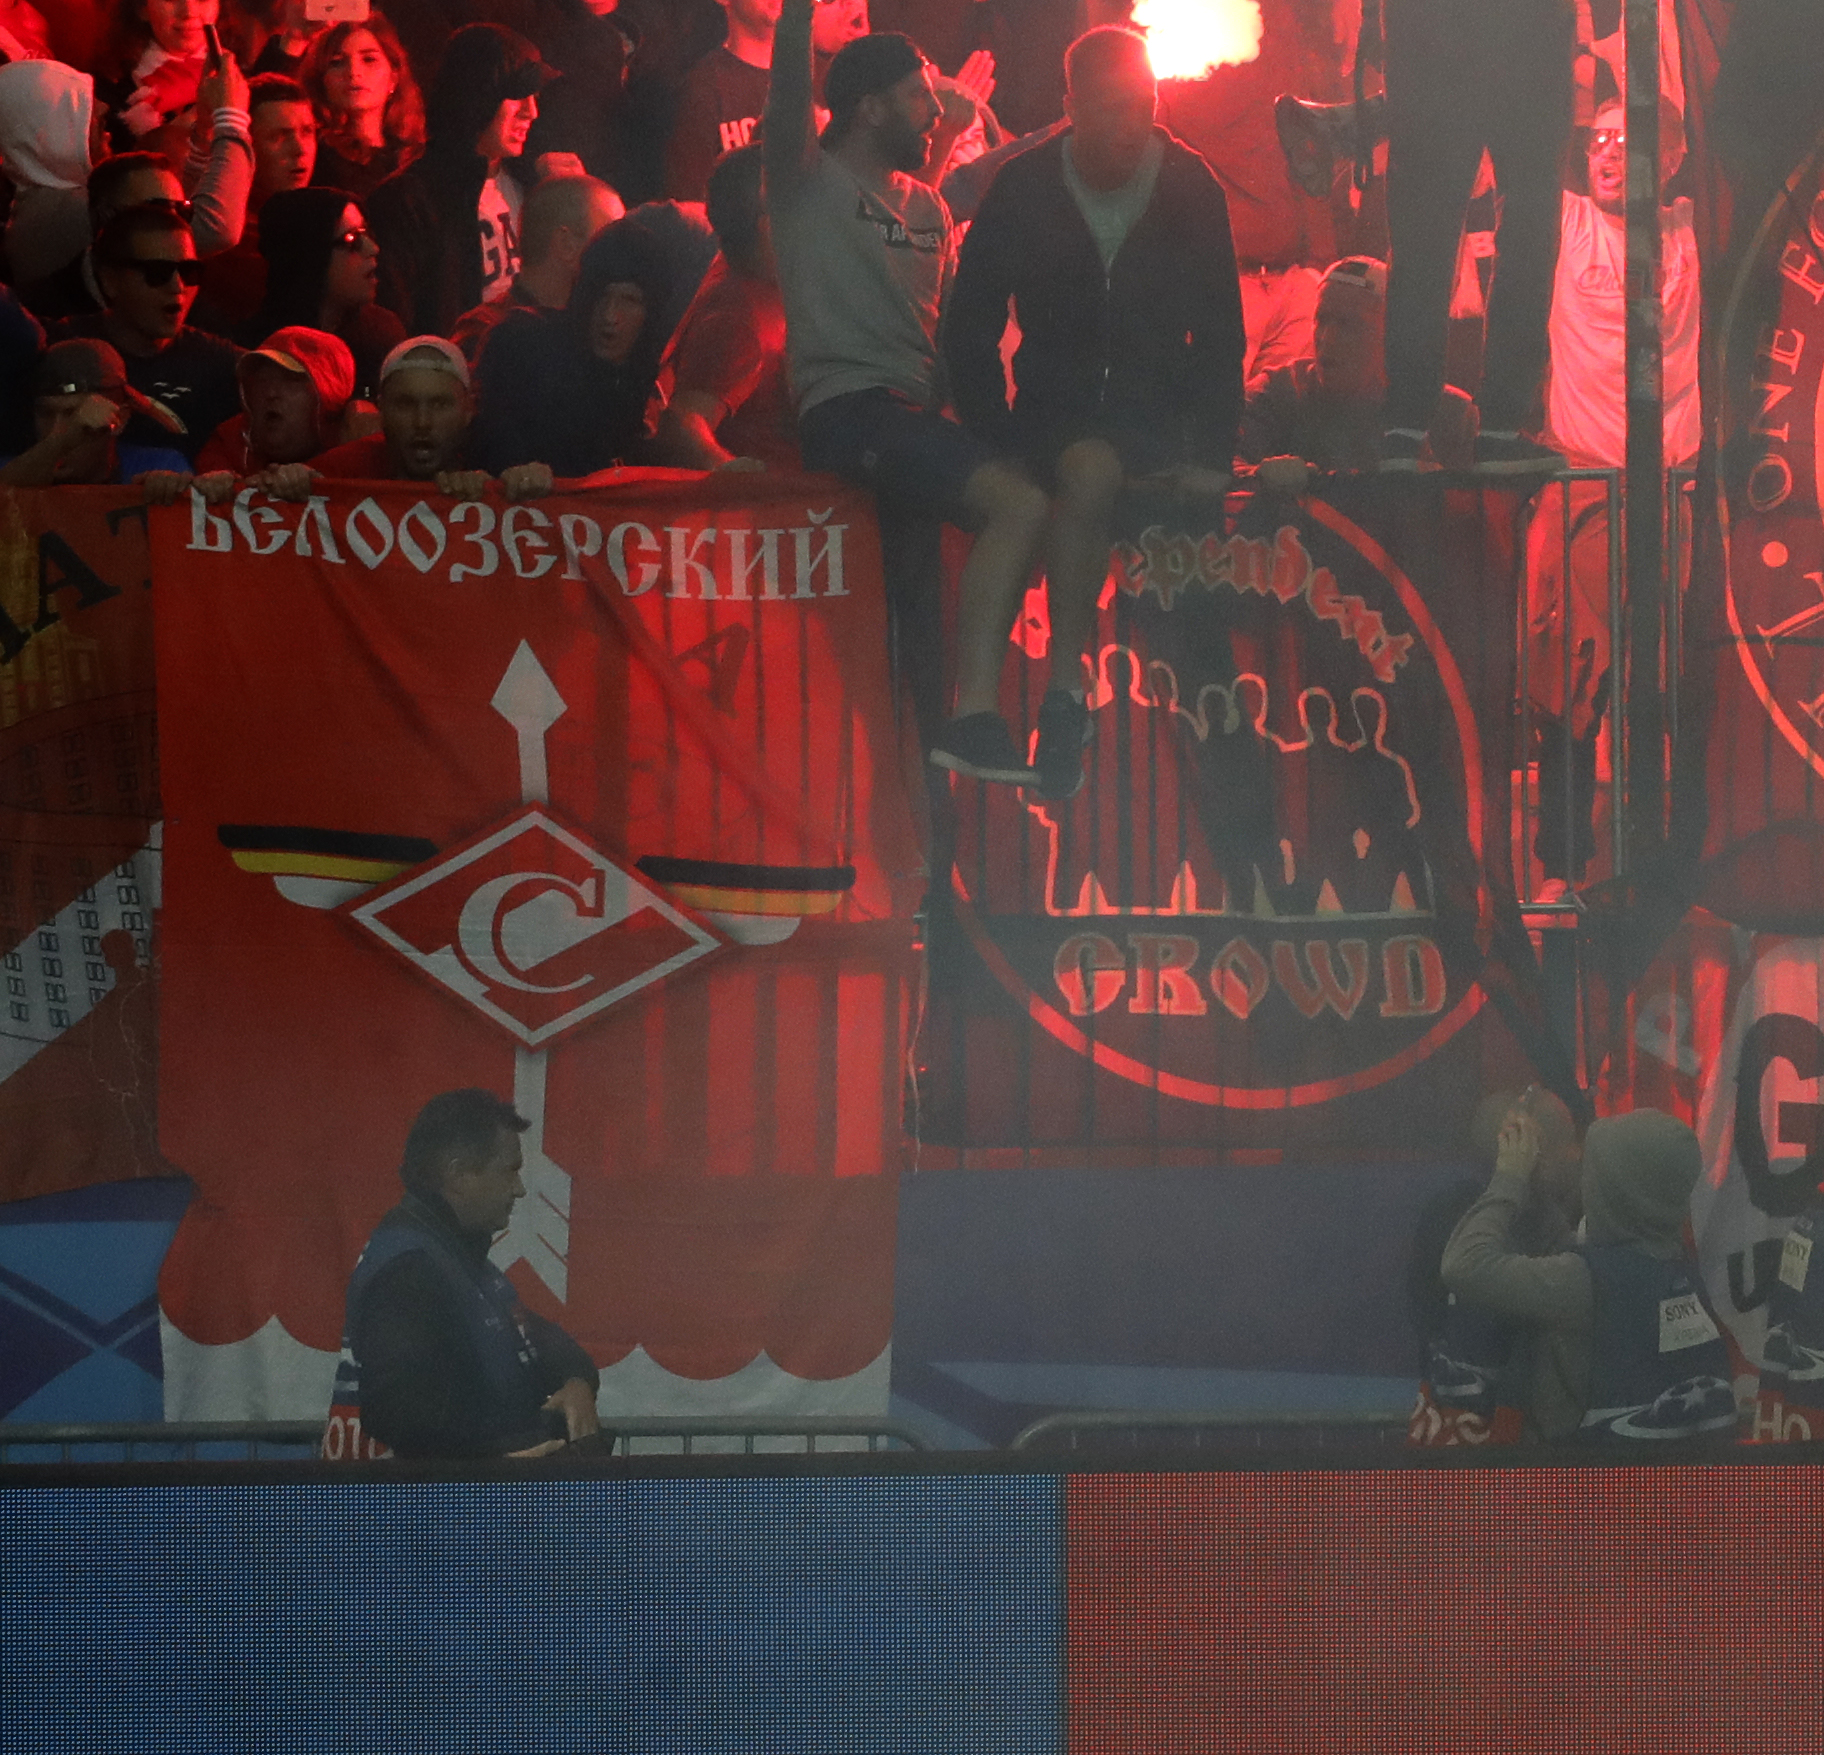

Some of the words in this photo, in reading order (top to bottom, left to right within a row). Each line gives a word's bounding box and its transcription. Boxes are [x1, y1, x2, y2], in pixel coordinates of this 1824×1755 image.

[1747, 326, 1807, 513] ONE
[1053, 929, 1449, 1020] CROWD
[1664, 1301, 1699, 1322] SONY
